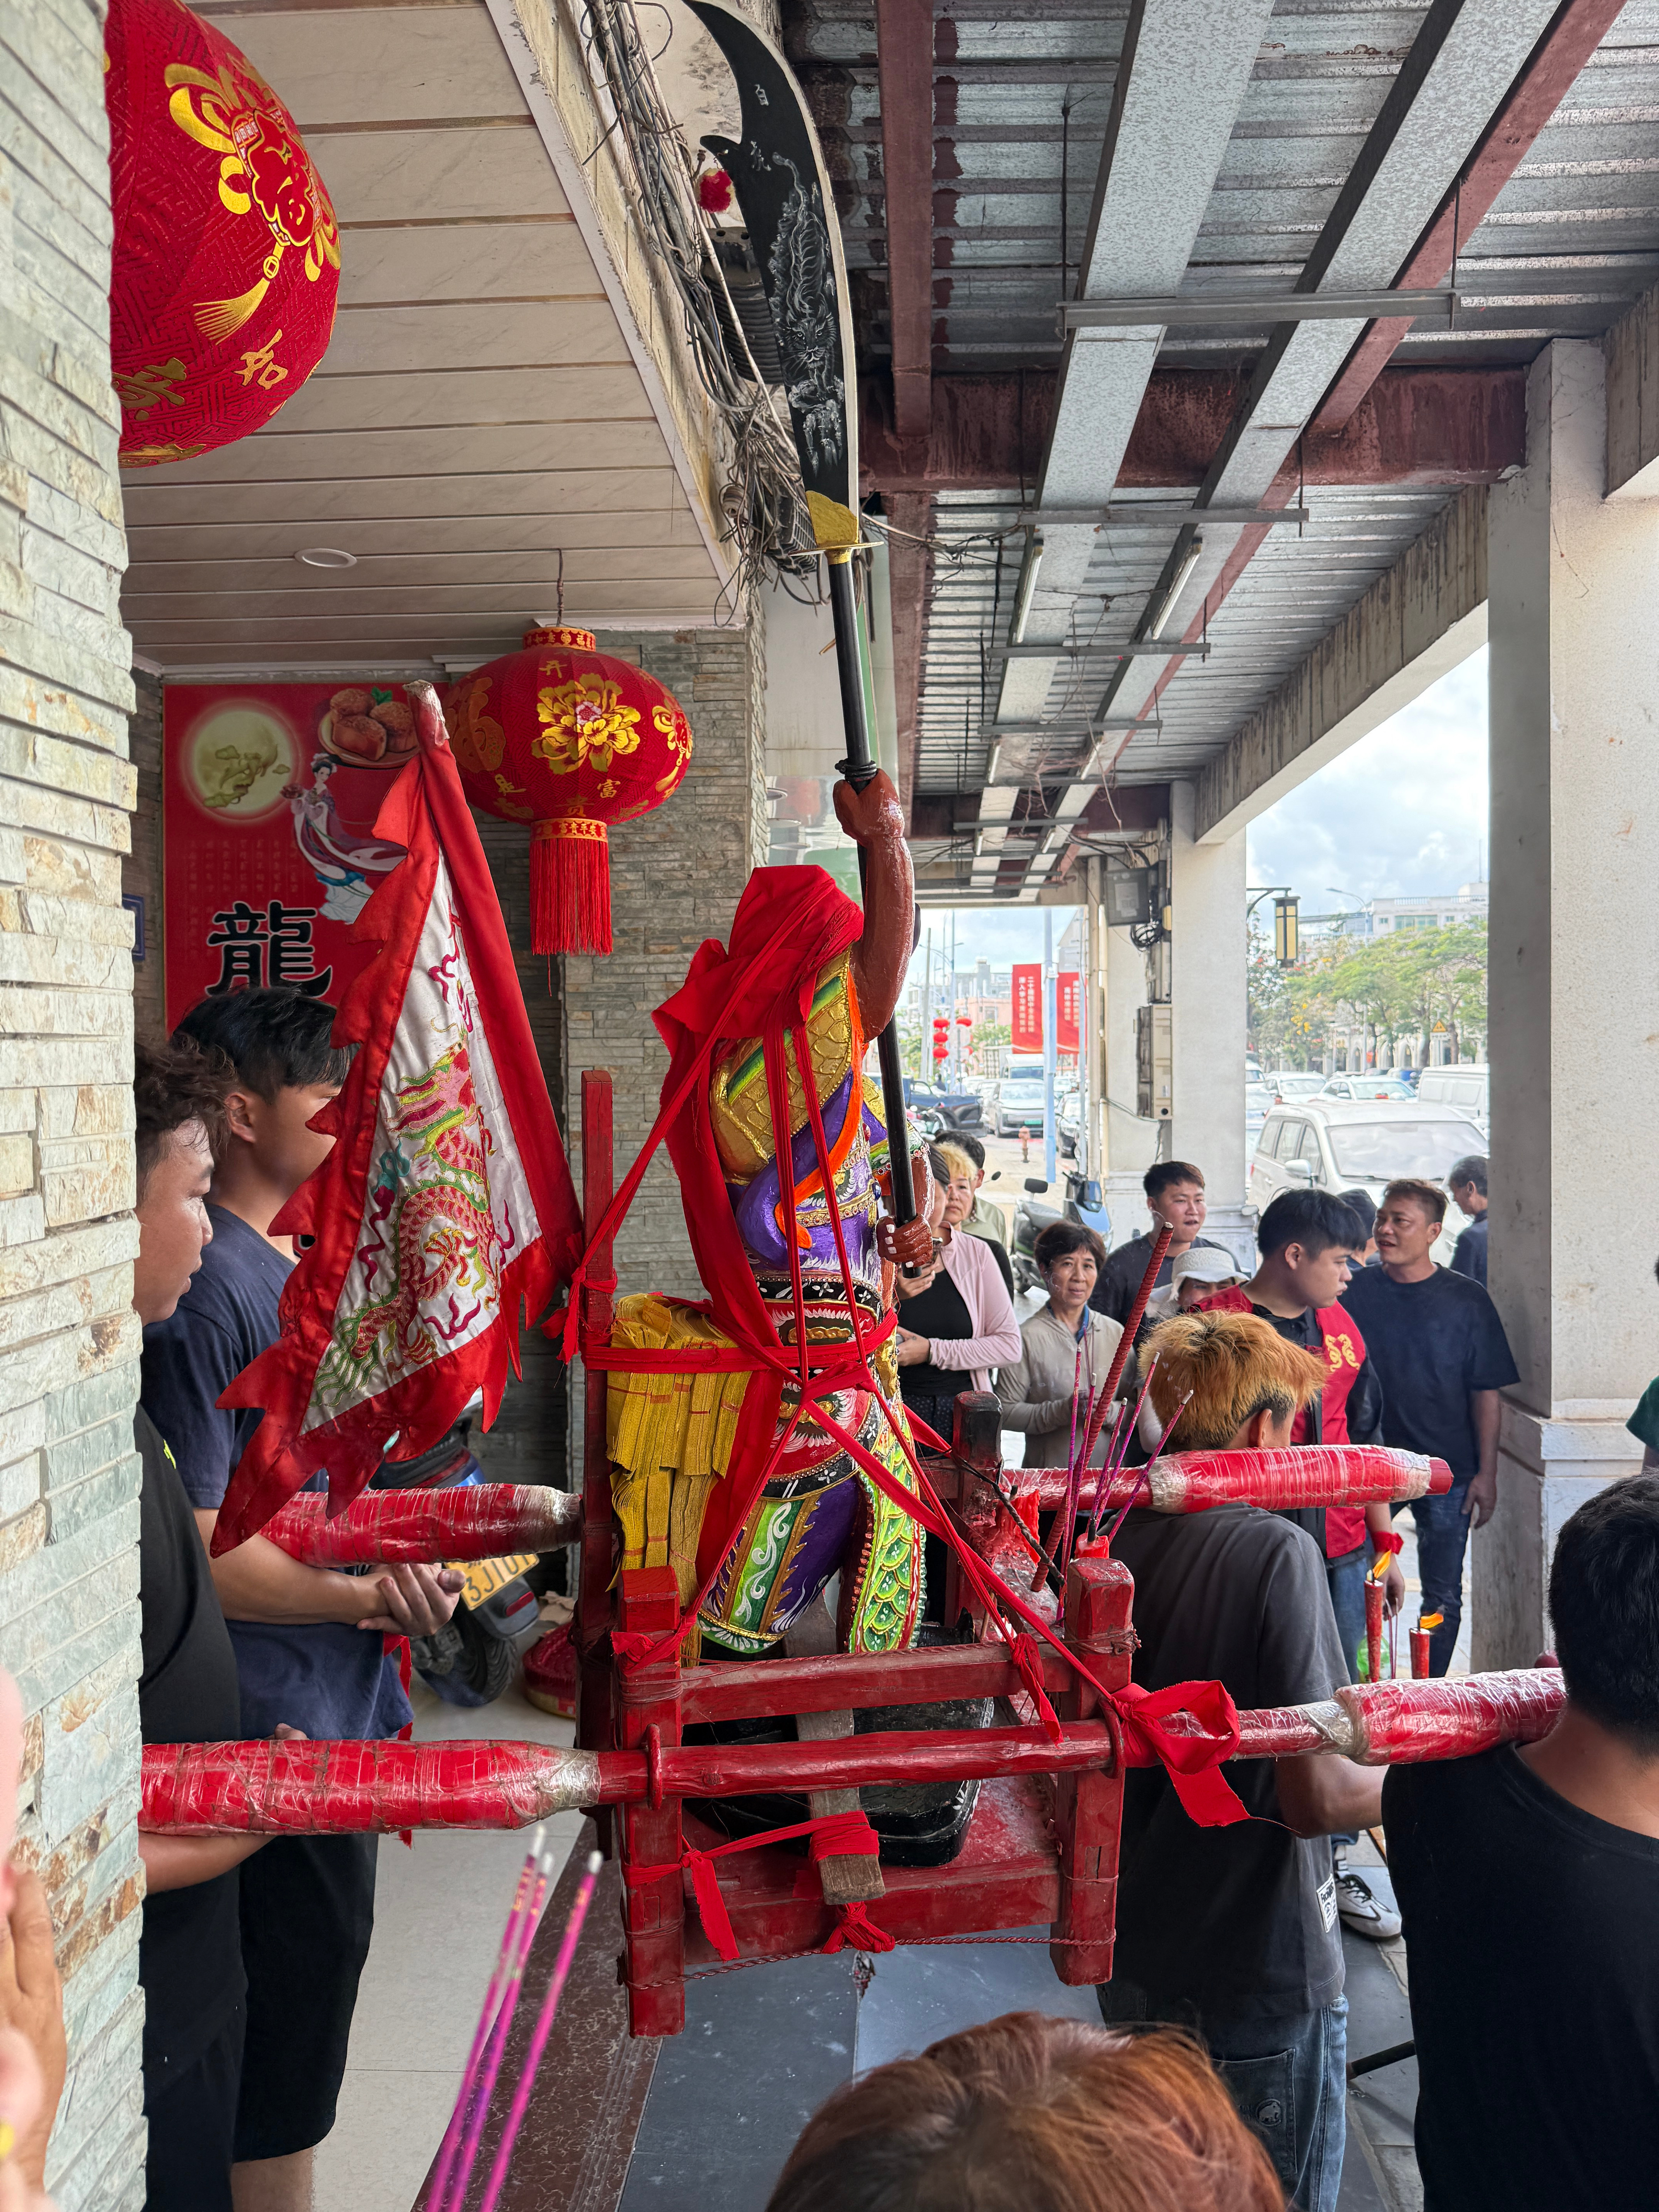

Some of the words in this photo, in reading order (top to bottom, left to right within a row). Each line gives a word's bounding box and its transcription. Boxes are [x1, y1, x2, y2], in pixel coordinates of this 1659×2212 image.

[234, 329, 288, 390] 如
[597, 779, 621, 799] 富
[205, 900, 333, 998] 龍
